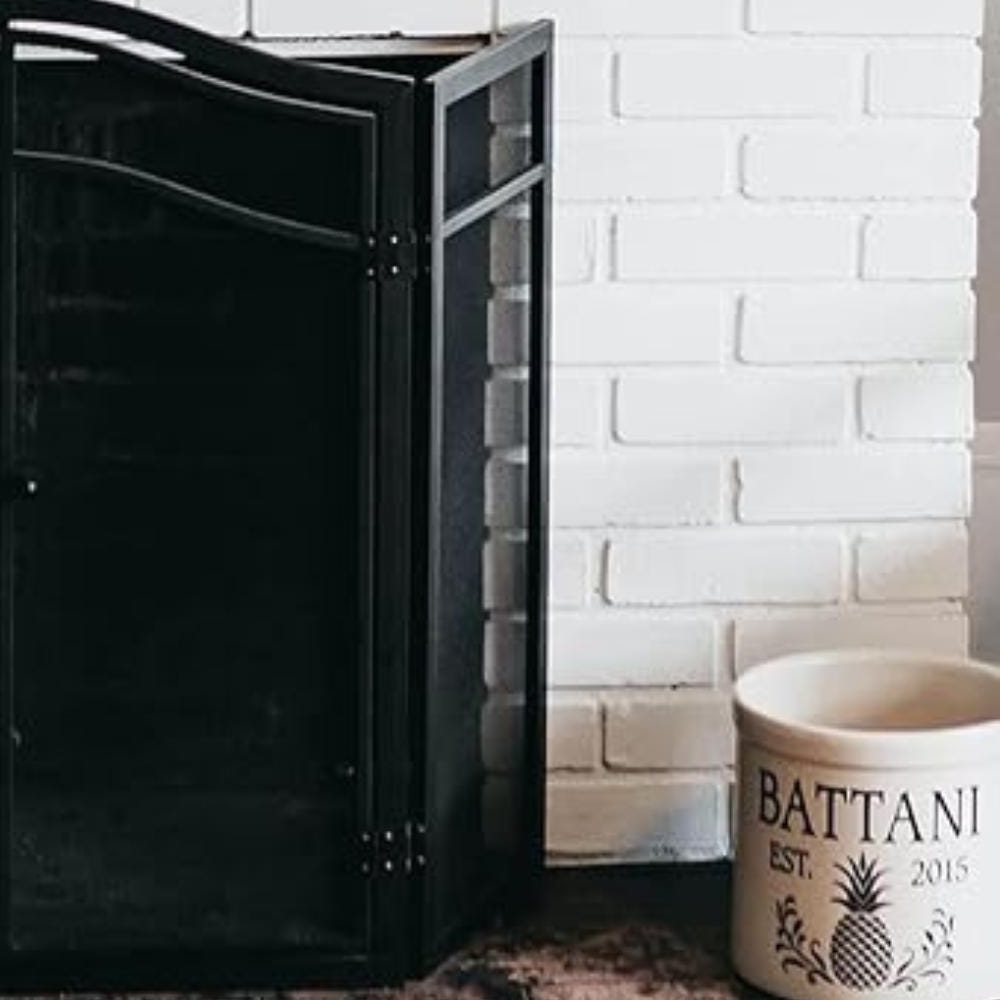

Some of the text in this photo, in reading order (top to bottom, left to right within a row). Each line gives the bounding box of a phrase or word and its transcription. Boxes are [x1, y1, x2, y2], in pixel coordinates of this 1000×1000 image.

[758, 766, 979, 844] BATTANI
[769, 840, 969, 887] EST. 2015
